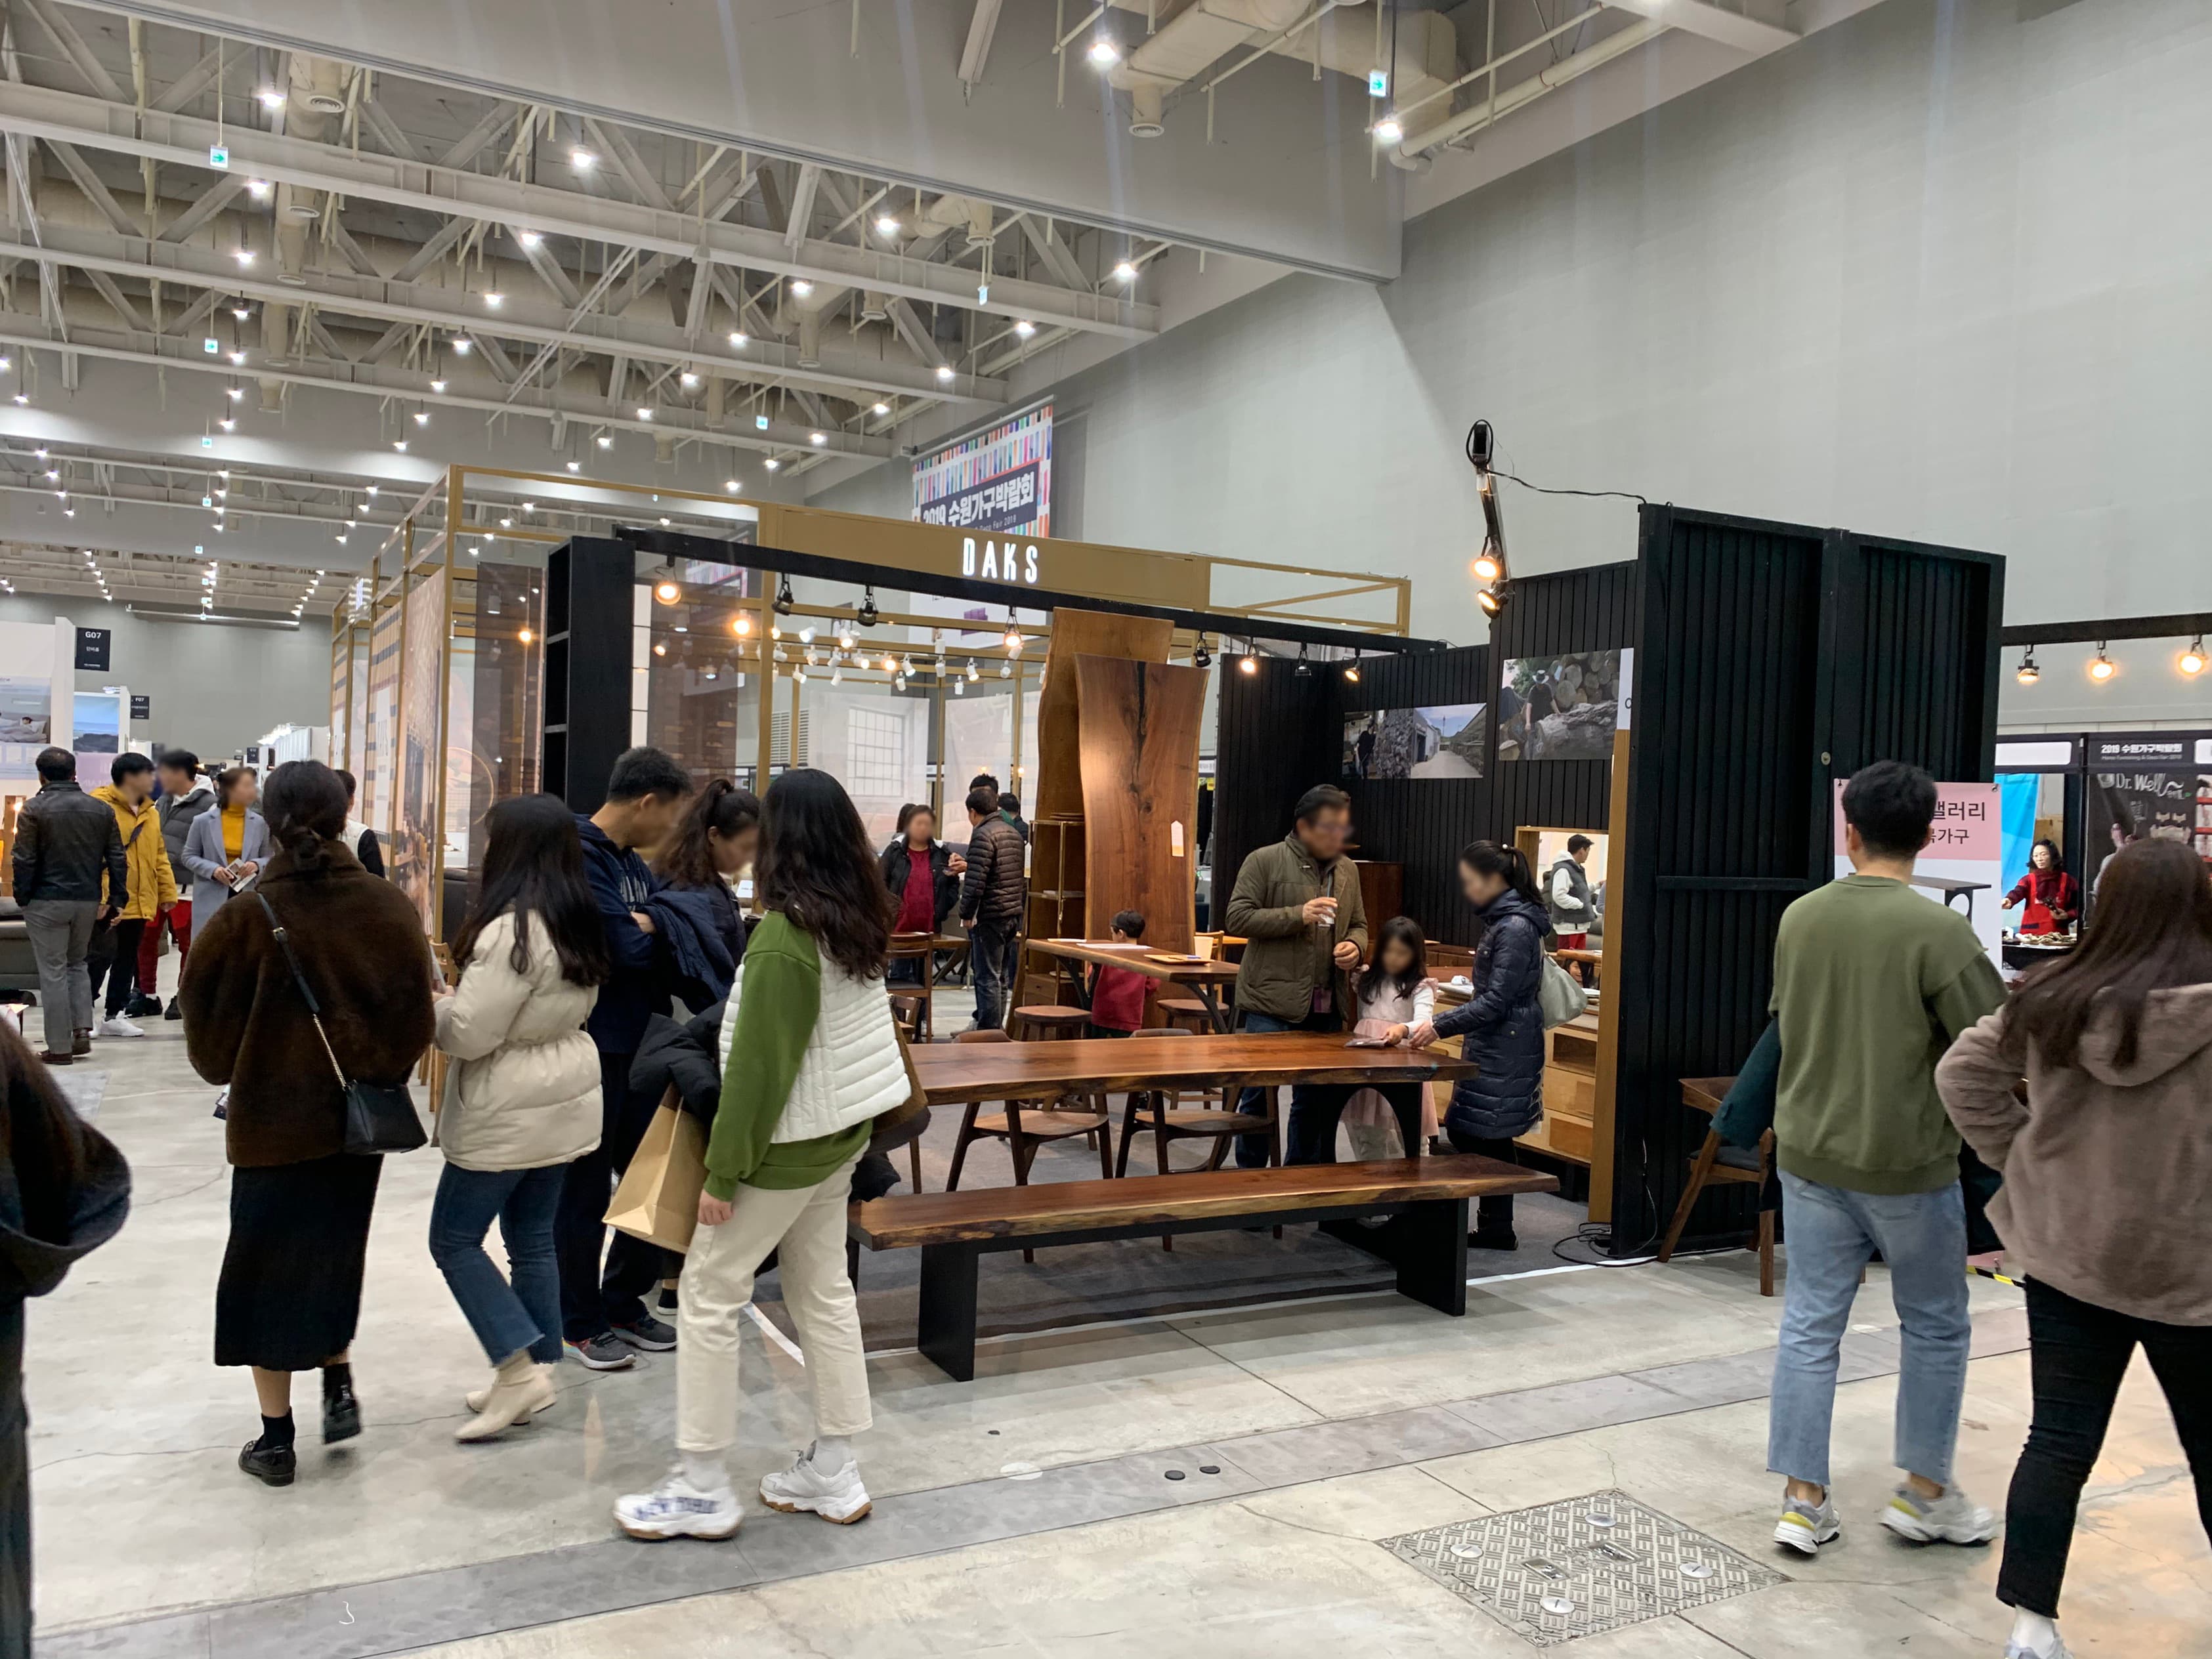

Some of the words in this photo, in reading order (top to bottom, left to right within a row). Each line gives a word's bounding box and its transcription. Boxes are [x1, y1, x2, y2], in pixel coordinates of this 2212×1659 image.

[923, 504, 946, 526] 2019
[948, 471, 1034, 527] 수원가구박람회
[992, 520, 1003, 530] Fair
[1004, 514, 1016, 526] 2019
[963, 537, 1038, 583] DAKS
[2116, 773, 2132, 789] Dr.
